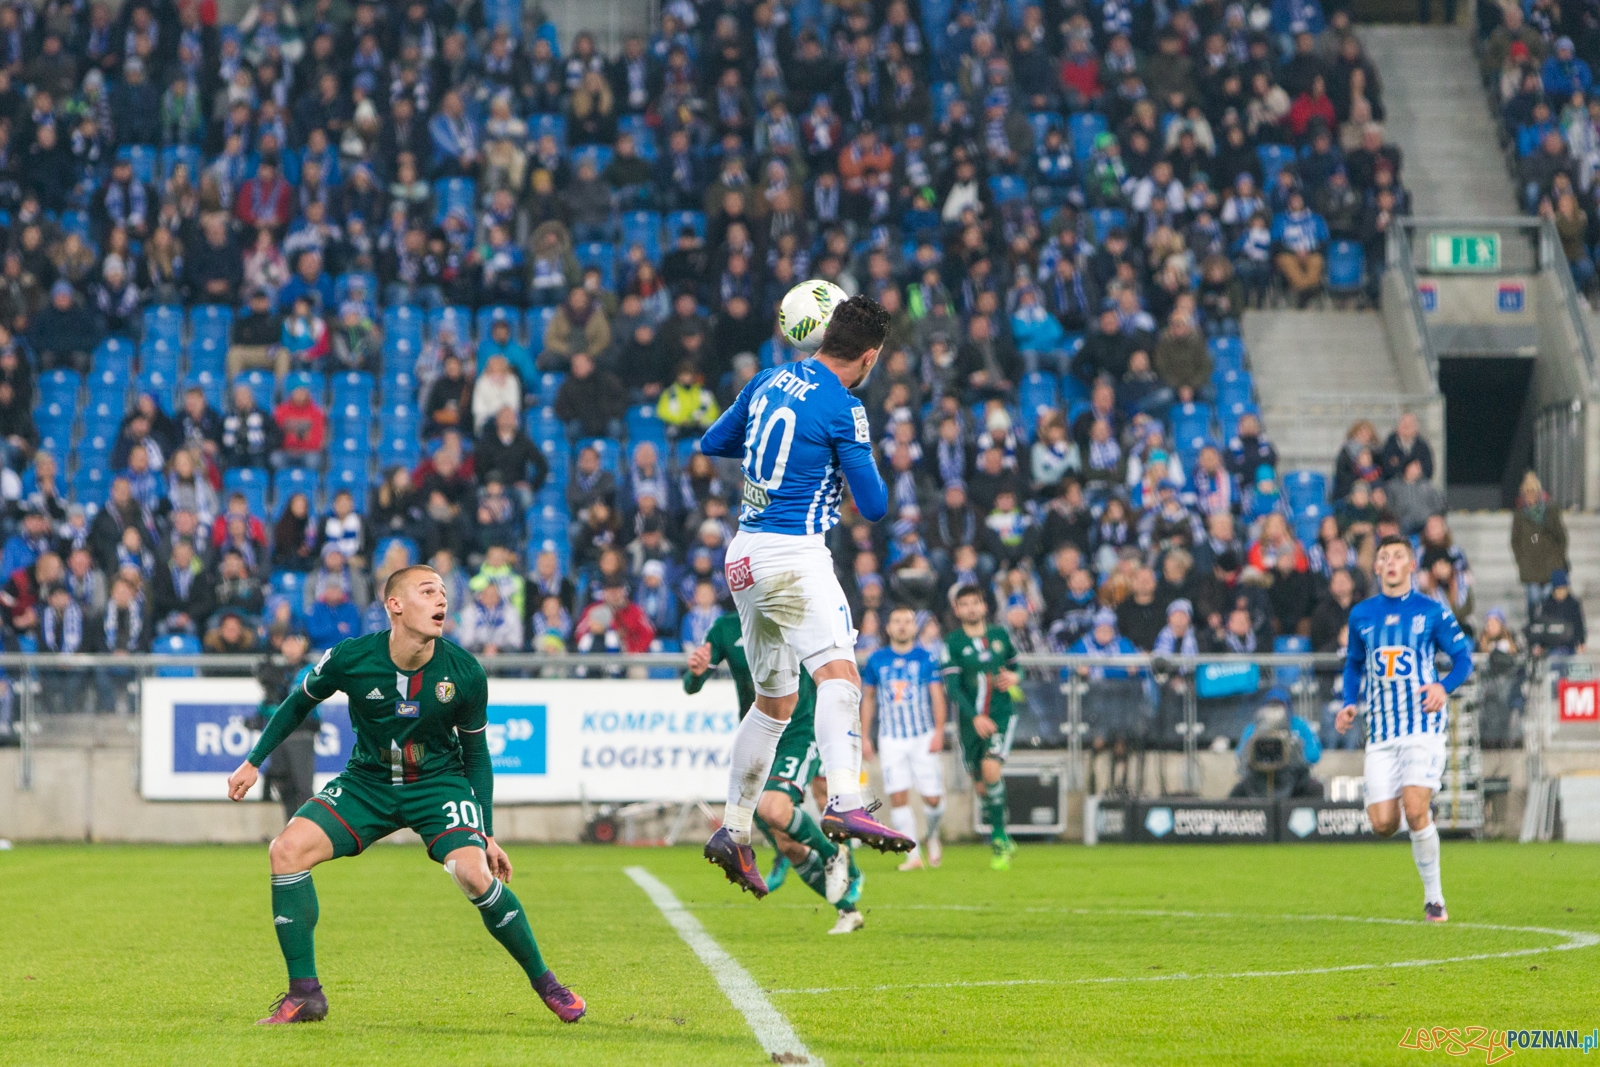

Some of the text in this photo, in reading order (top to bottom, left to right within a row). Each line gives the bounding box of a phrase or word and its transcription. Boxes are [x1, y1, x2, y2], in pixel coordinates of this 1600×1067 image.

[768, 369, 819, 402] JEVTIĆ
[742, 394, 796, 490] 10
[743, 481, 767, 505] LECH
[1374, 650, 1413, 678] STS
[196, 715, 341, 757] RÖG
[582, 711, 738, 734] KOMPLEKS
[778, 756, 800, 779] 3
[442, 800, 479, 830] 30
